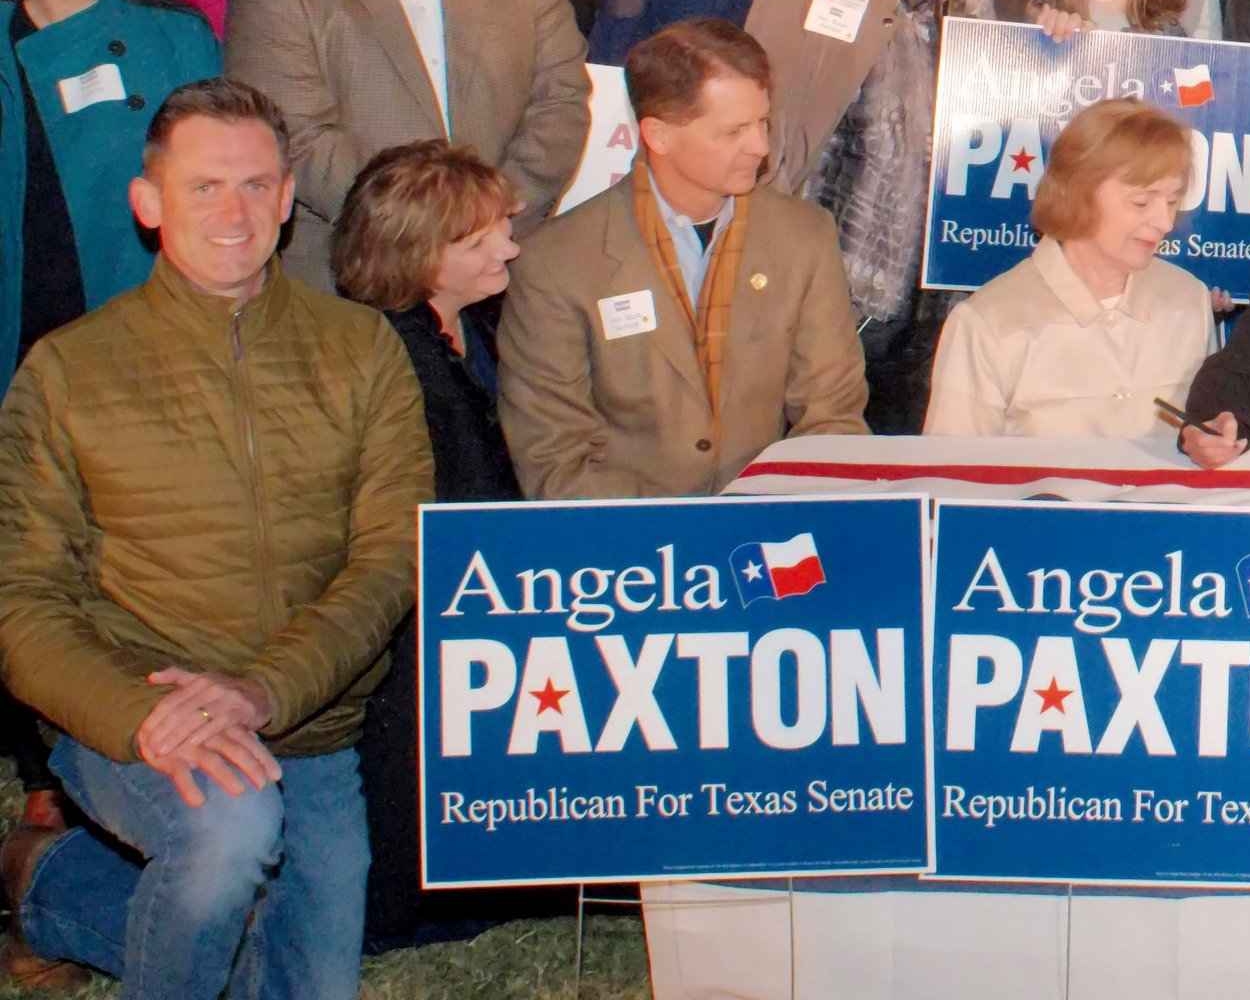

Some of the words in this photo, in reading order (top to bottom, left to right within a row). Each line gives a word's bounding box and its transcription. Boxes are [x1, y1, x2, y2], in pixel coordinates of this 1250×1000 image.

[964, 54, 1144, 117] Angela
[440, 544, 728, 632] Angela
[952, 546, 1233, 634] Angela
[440, 627, 906, 758] PAXTON
[440, 788, 627, 831] Republican
[634, 786, 692, 818] For
[700, 783, 798, 817] Texas
[806, 779, 914, 814] Senate
[942, 786, 1123, 828] Republican
[1132, 790, 1189, 822] For
